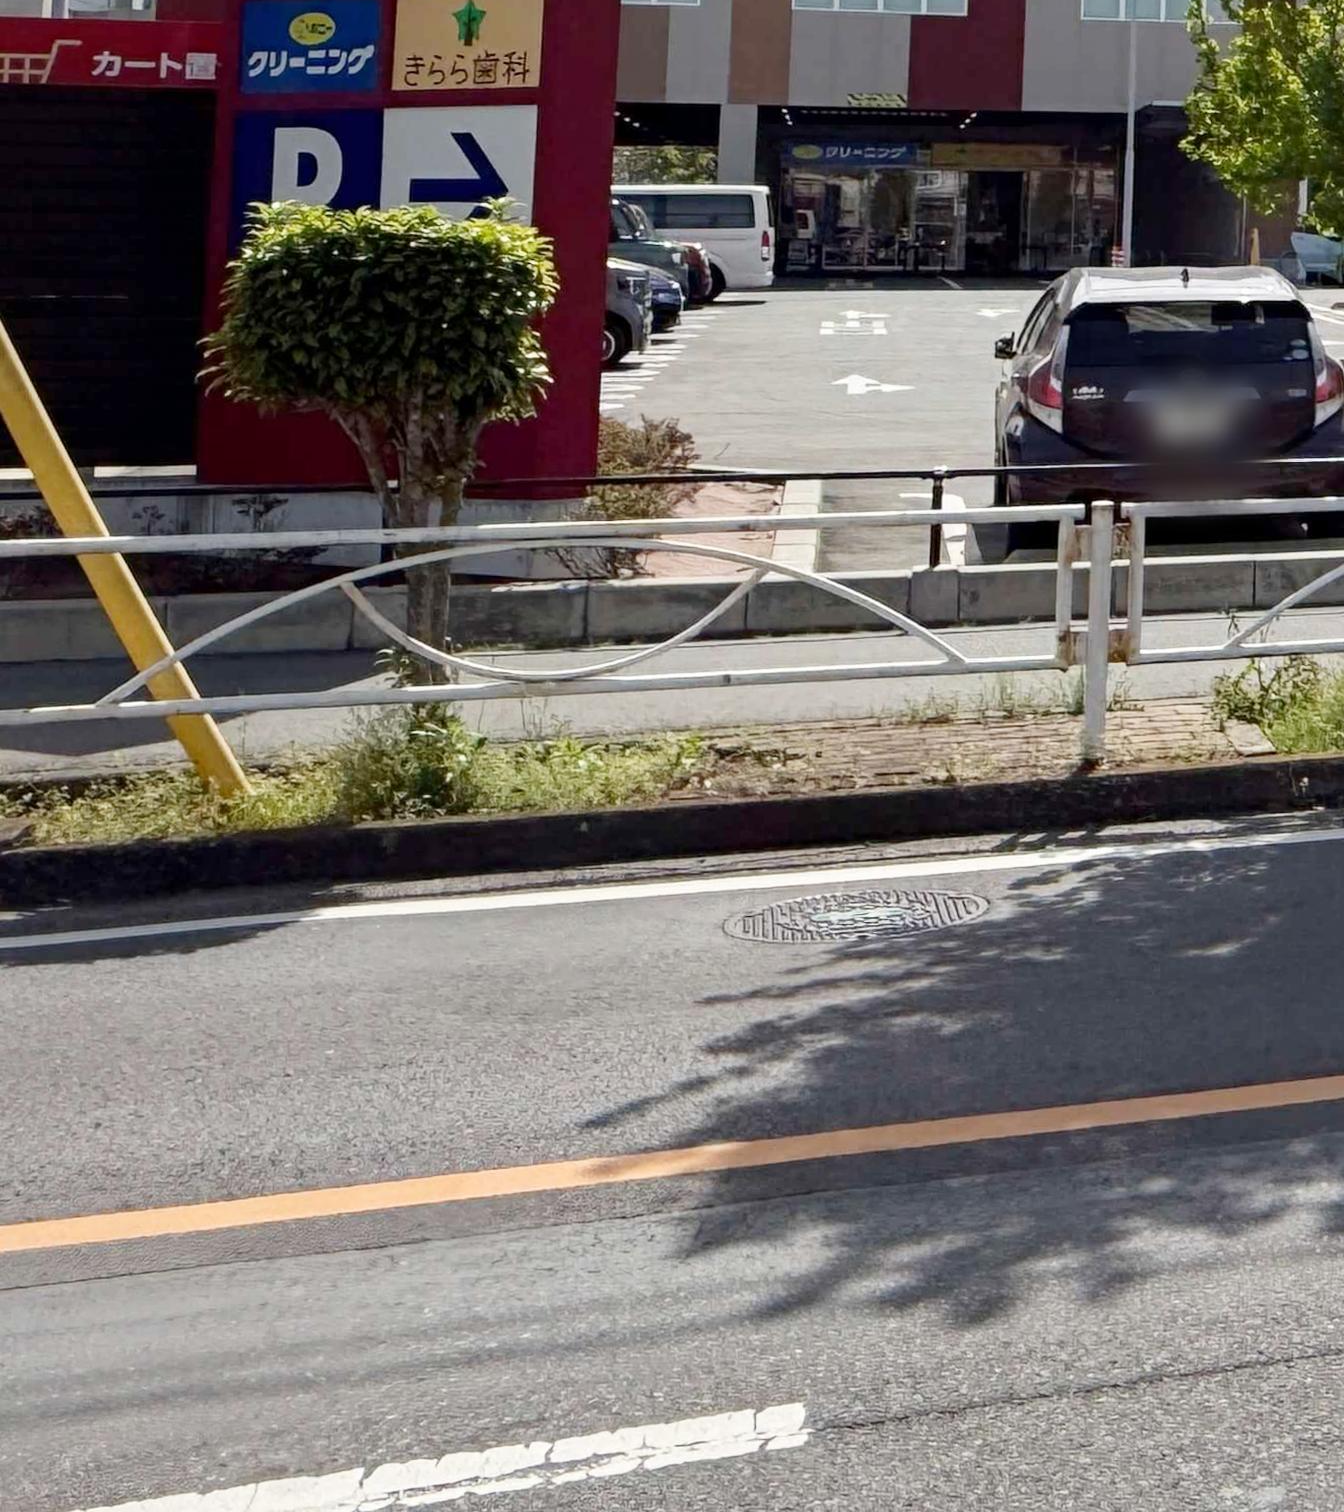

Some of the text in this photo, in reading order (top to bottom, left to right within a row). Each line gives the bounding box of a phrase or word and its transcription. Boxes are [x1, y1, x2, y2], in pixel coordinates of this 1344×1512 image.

[248, 45, 375, 77] クリーニング
[404, 50, 530, 85] きらら歯科
